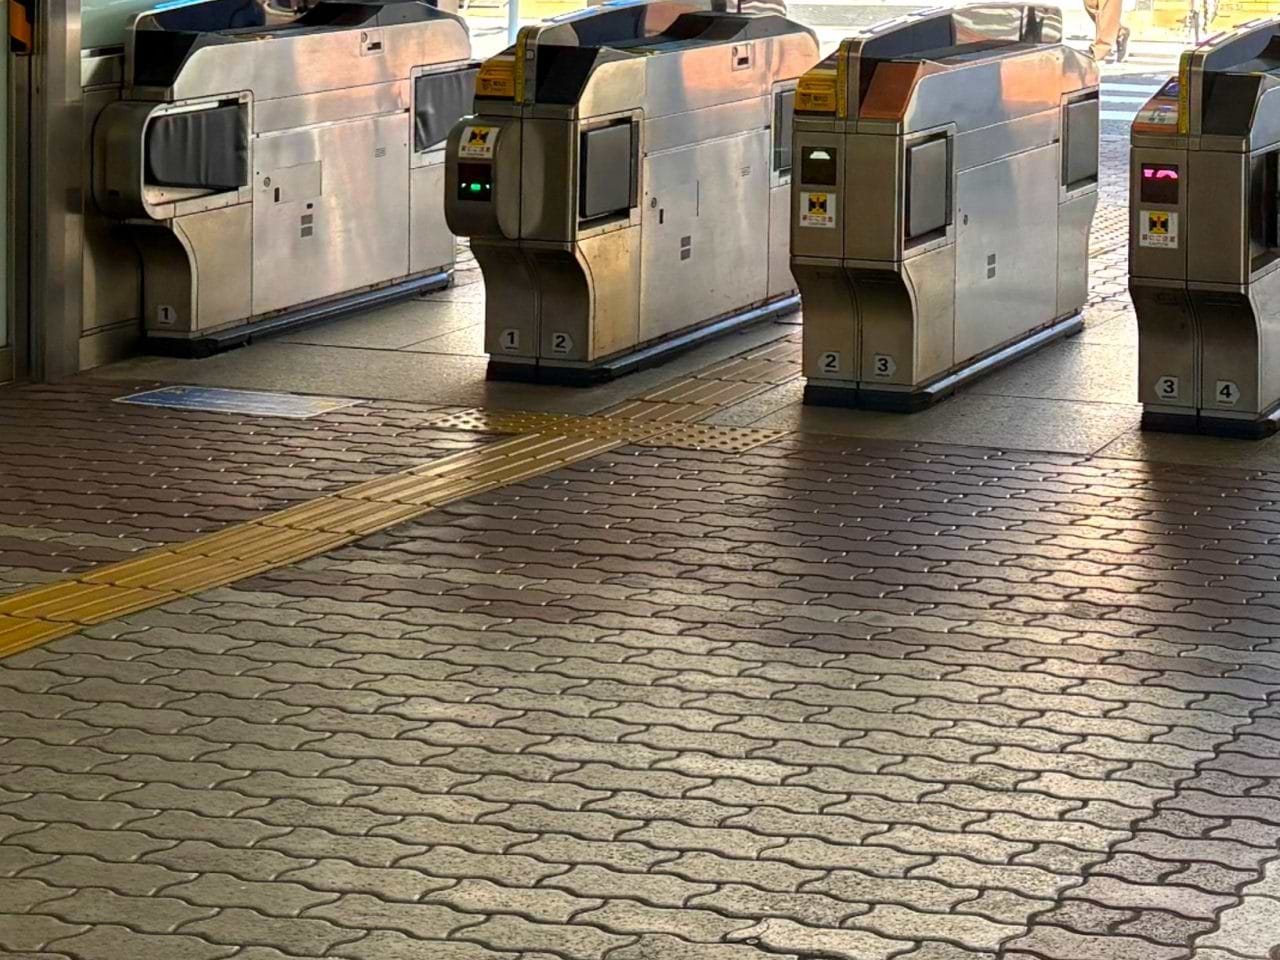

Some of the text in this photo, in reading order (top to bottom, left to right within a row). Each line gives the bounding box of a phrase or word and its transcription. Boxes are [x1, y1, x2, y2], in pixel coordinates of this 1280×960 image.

[161, 307, 168, 320] 1
[506, 331, 515, 345] 1
[555, 334, 567, 349] 2
[825, 354, 836, 368] 2
[877, 358, 888, 372] 3
[1163, 379, 1174, 394] 3
[1219, 384, 1232, 398] 4
